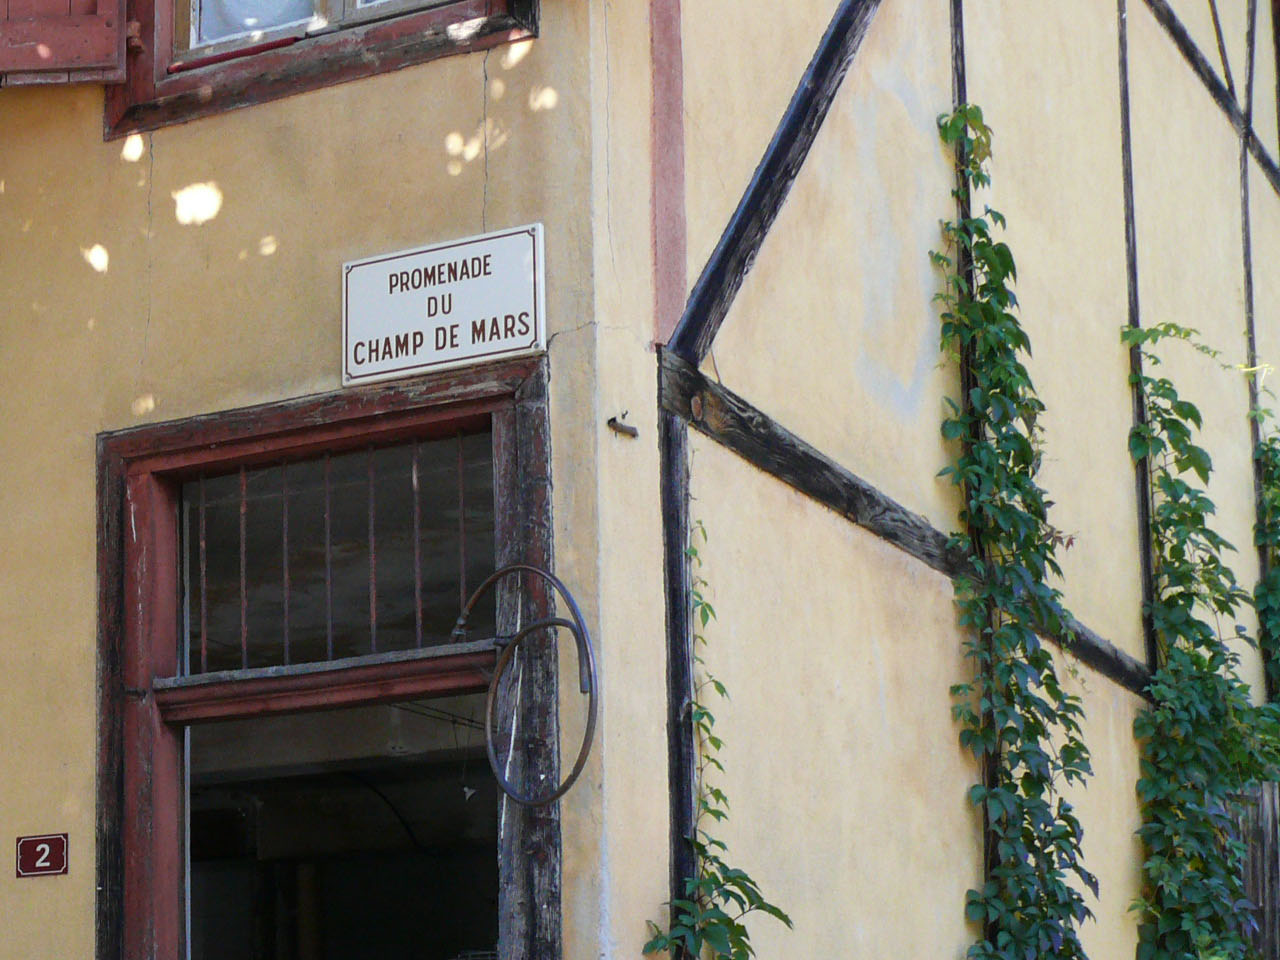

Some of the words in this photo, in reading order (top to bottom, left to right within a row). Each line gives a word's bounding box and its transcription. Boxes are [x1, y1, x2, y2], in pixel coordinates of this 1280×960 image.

[389, 254, 492, 294] PROMENADE
[427, 293, 452, 318] DU
[353, 331, 424, 365] CHAMP
[435, 324, 460, 351] DE
[471, 311, 530, 344] MARS
[35, 843, 51, 868] 2
